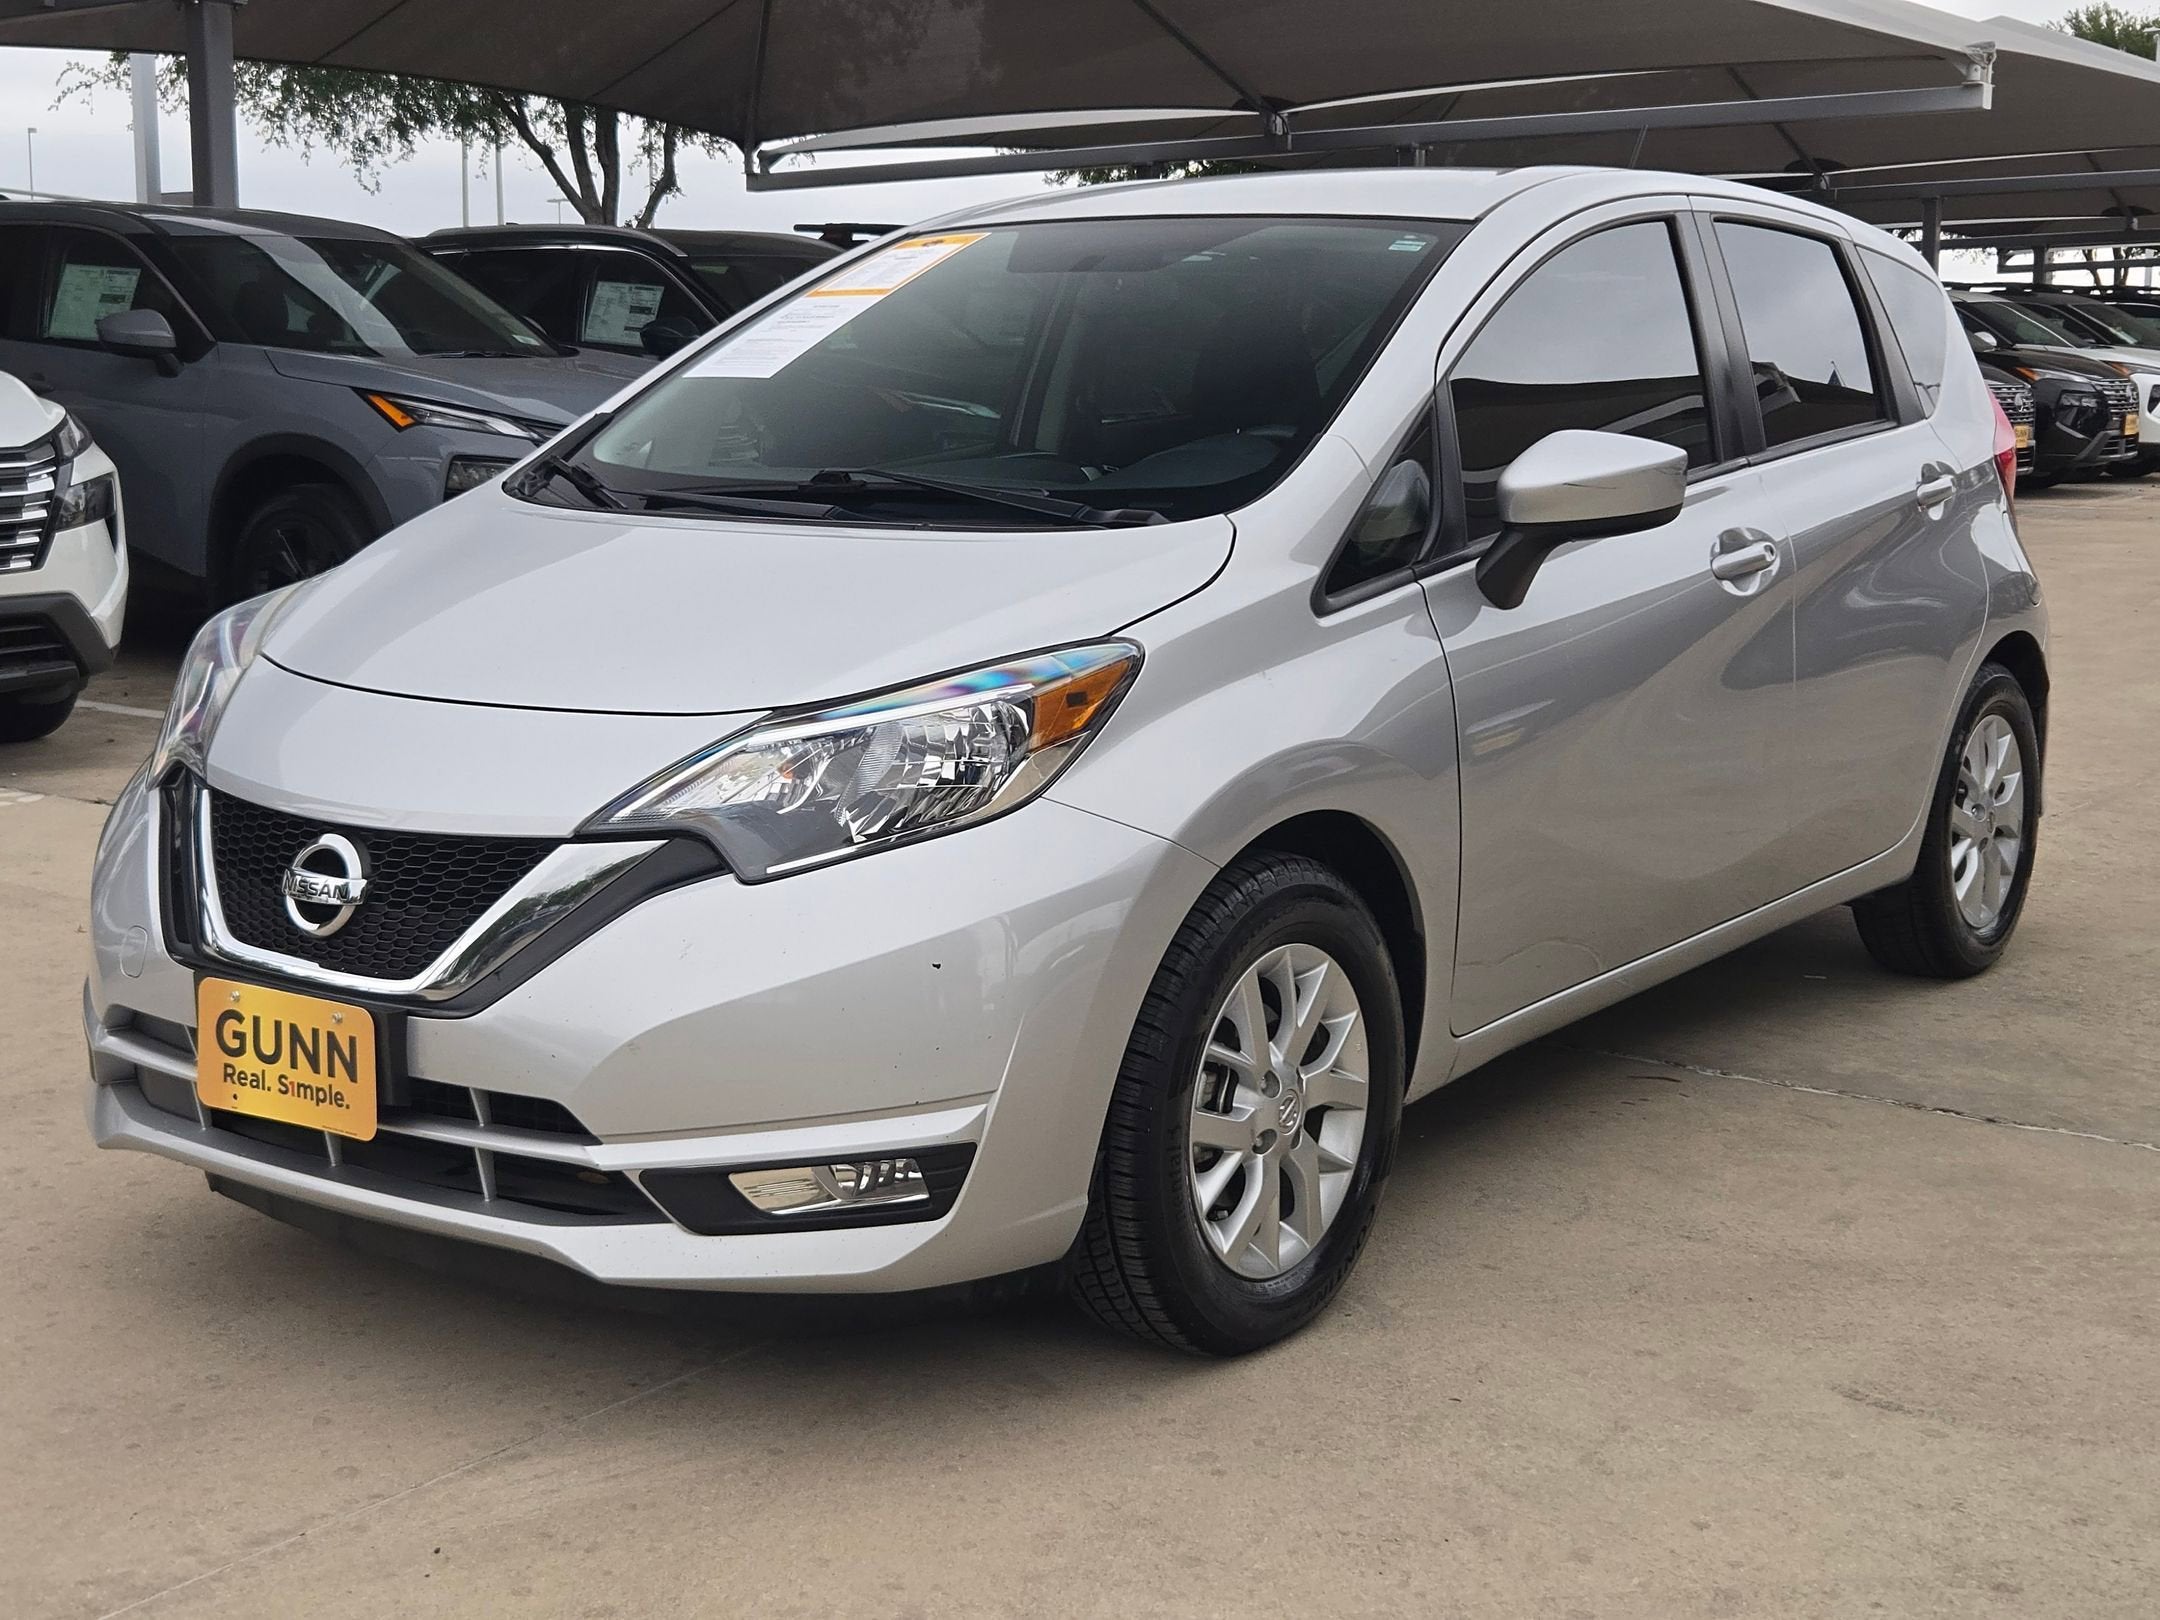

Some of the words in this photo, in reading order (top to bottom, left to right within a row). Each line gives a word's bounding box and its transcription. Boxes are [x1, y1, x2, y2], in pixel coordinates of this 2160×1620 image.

[286, 873, 349, 900] NISSAN
[215, 1008, 358, 1084] GUNN
[223, 1062, 272, 1092] Real.
